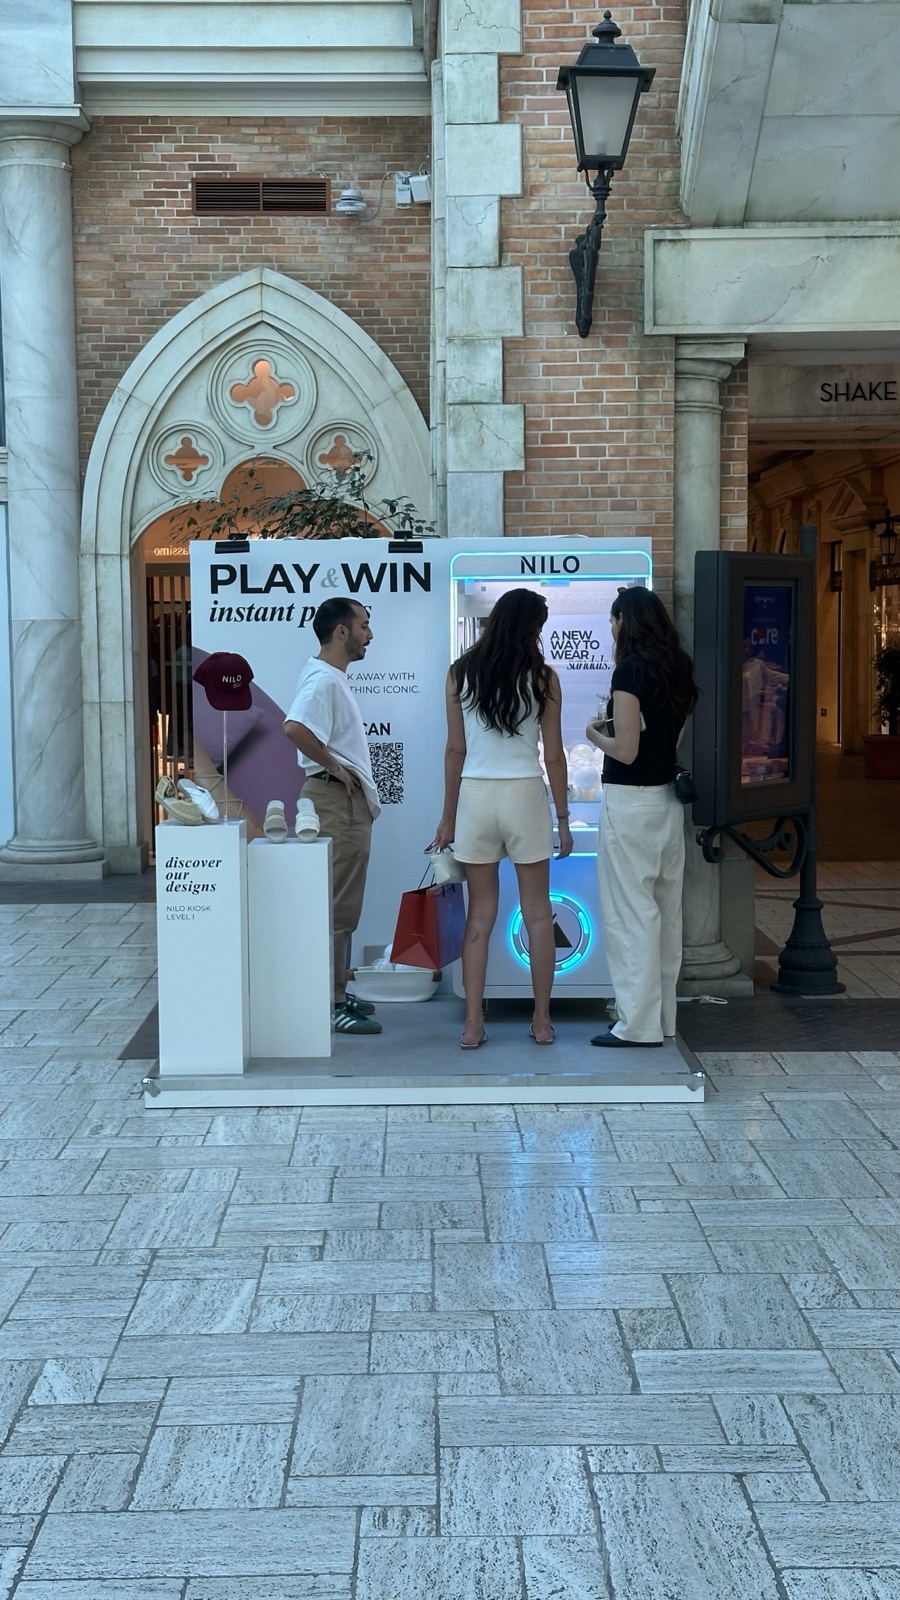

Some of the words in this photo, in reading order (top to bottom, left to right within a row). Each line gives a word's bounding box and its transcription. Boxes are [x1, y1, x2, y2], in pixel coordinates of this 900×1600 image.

[820, 381, 897, 402] SHAKE
[520, 555, 580, 574] NILO
[209, 600, 295, 622] instant
[550, 630, 560, 640] A
[562, 630, 593, 641] NEW
[550, 640, 581, 650] WAY
[582, 640, 600, 650] TO
[550, 650, 589, 660] WEAR
[222, 674, 242, 683] NILO
[356, 672, 387, 681] AWAY
[388, 672, 415, 681] WITH
[350, 685, 381, 694] THING
[383, 685, 421, 694] ICONIC.
[165, 857, 222, 868] discover
[165, 872, 190, 880] our
[165, 880, 217, 895] designs
[166, 913, 190, 921] LEVEL
